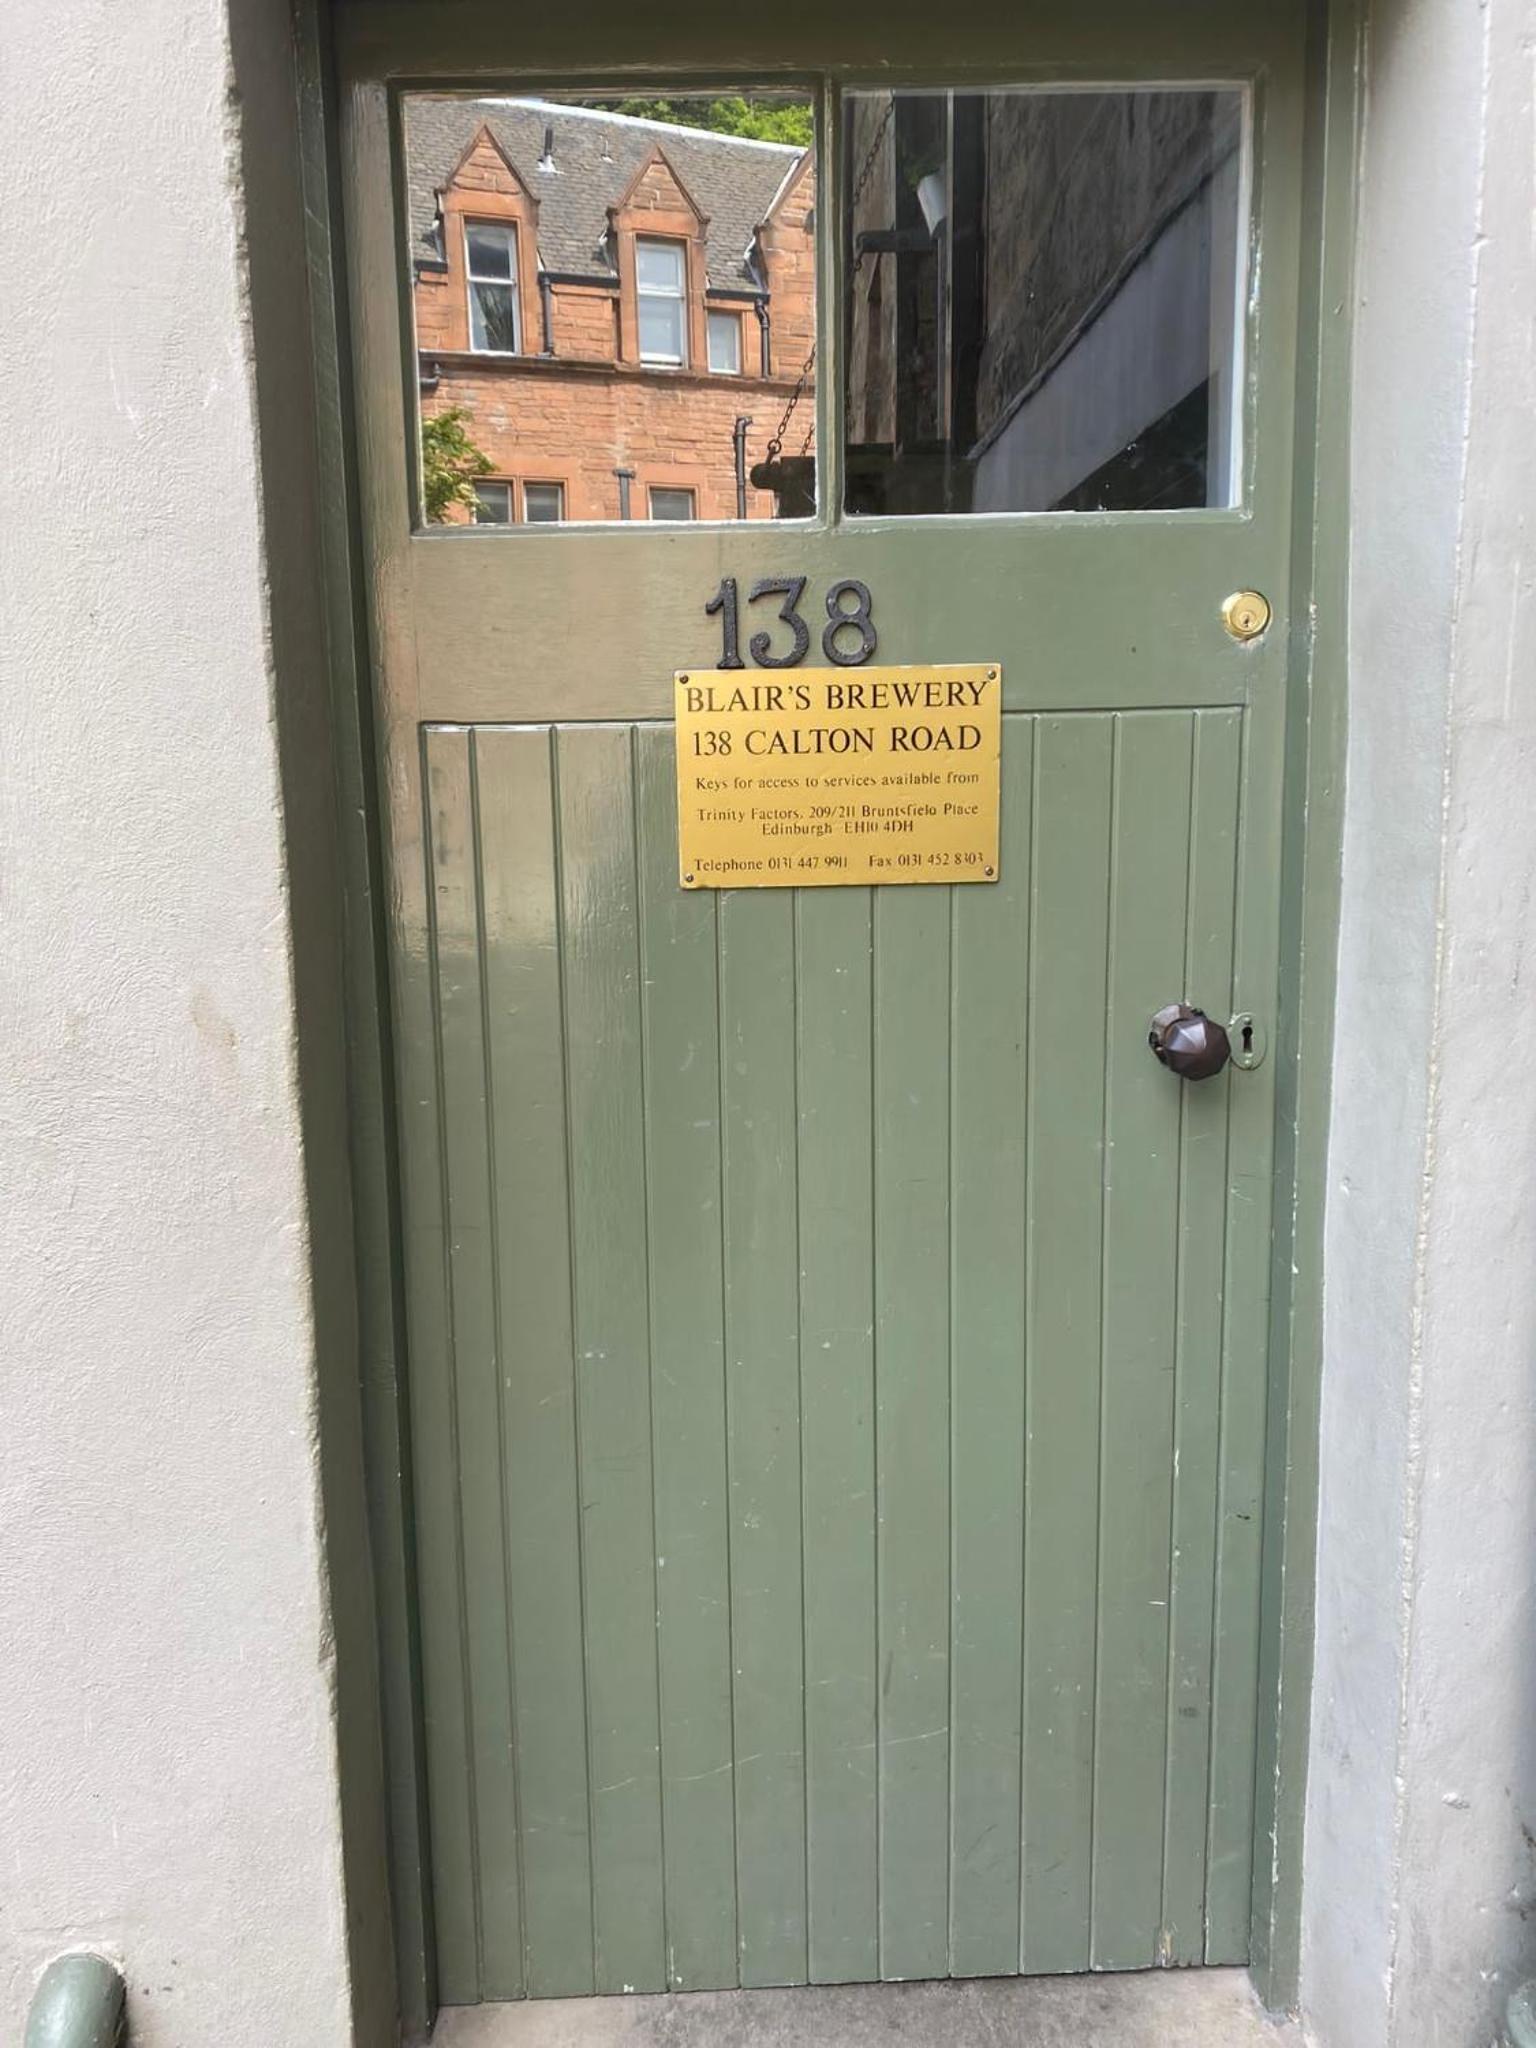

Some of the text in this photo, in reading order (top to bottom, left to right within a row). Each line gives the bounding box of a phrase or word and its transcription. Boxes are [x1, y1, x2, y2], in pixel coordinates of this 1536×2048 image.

[705, 575, 877, 669] 138
[686, 680, 988, 713] BLAIR'S BREWERY
[692, 724, 981, 756] 138 CALTON ROAD
[696, 771, 979, 792] Keys for access to services available from
[697, 807, 746, 822] Trinity
[809, 806, 856, 819] 209/211
[862, 804, 937, 818] Bruntsfield
[944, 803, 979, 816] Place
[762, 820, 914, 837] Edinburgh EH10 4DH
[695, 856, 848, 873] Telephone 0131 447 9911
[869, 854, 892, 868] Fax
[897, 853, 922, 867] 0131
[927, 852, 950, 865] 452
